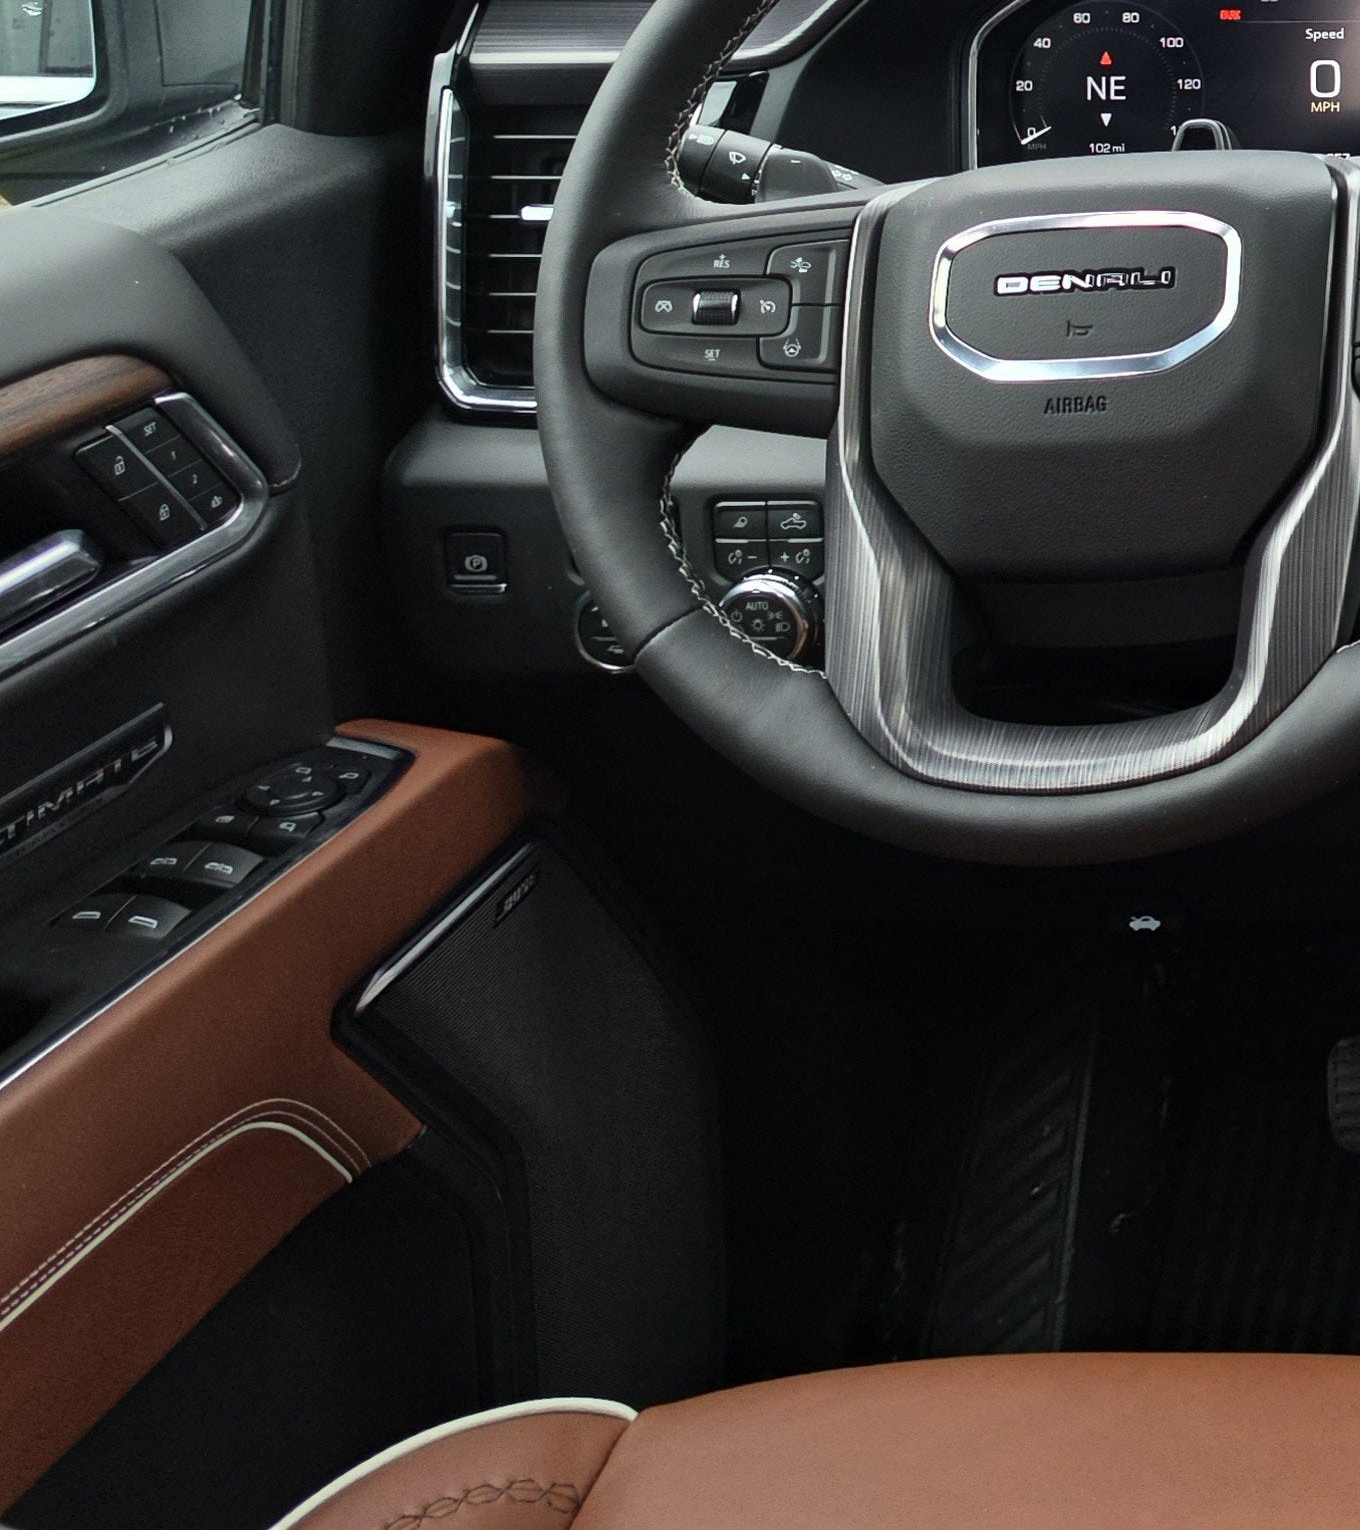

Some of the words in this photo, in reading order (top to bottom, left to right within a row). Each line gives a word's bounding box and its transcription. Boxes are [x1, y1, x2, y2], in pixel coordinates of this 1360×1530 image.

[1073, 12, 1091, 24] 60
[1122, 12, 1140, 23] 80
[1305, 27, 1344, 42] Speed
[1033, 37, 1051, 48] 40
[1159, 37, 1184, 48] 100
[1309, 59, 1341, 98] 0
[1015, 80, 1033, 91] 20
[1086, 75, 1127, 101] NE
[1176, 79, 1201, 90] 120
[1310, 101, 1340, 113] MPH
[1089, 143, 1111, 153] 102
[1112, 142, 1125, 153] mi
[713, 258, 730, 269] RES
[996, 266, 1175, 296] DENALI
[704, 349, 721, 359] SET
[1043, 395, 1108, 415] AIRBAG
[144, 421, 157, 437] SET
[745, 601, 769, 611] AUTO
